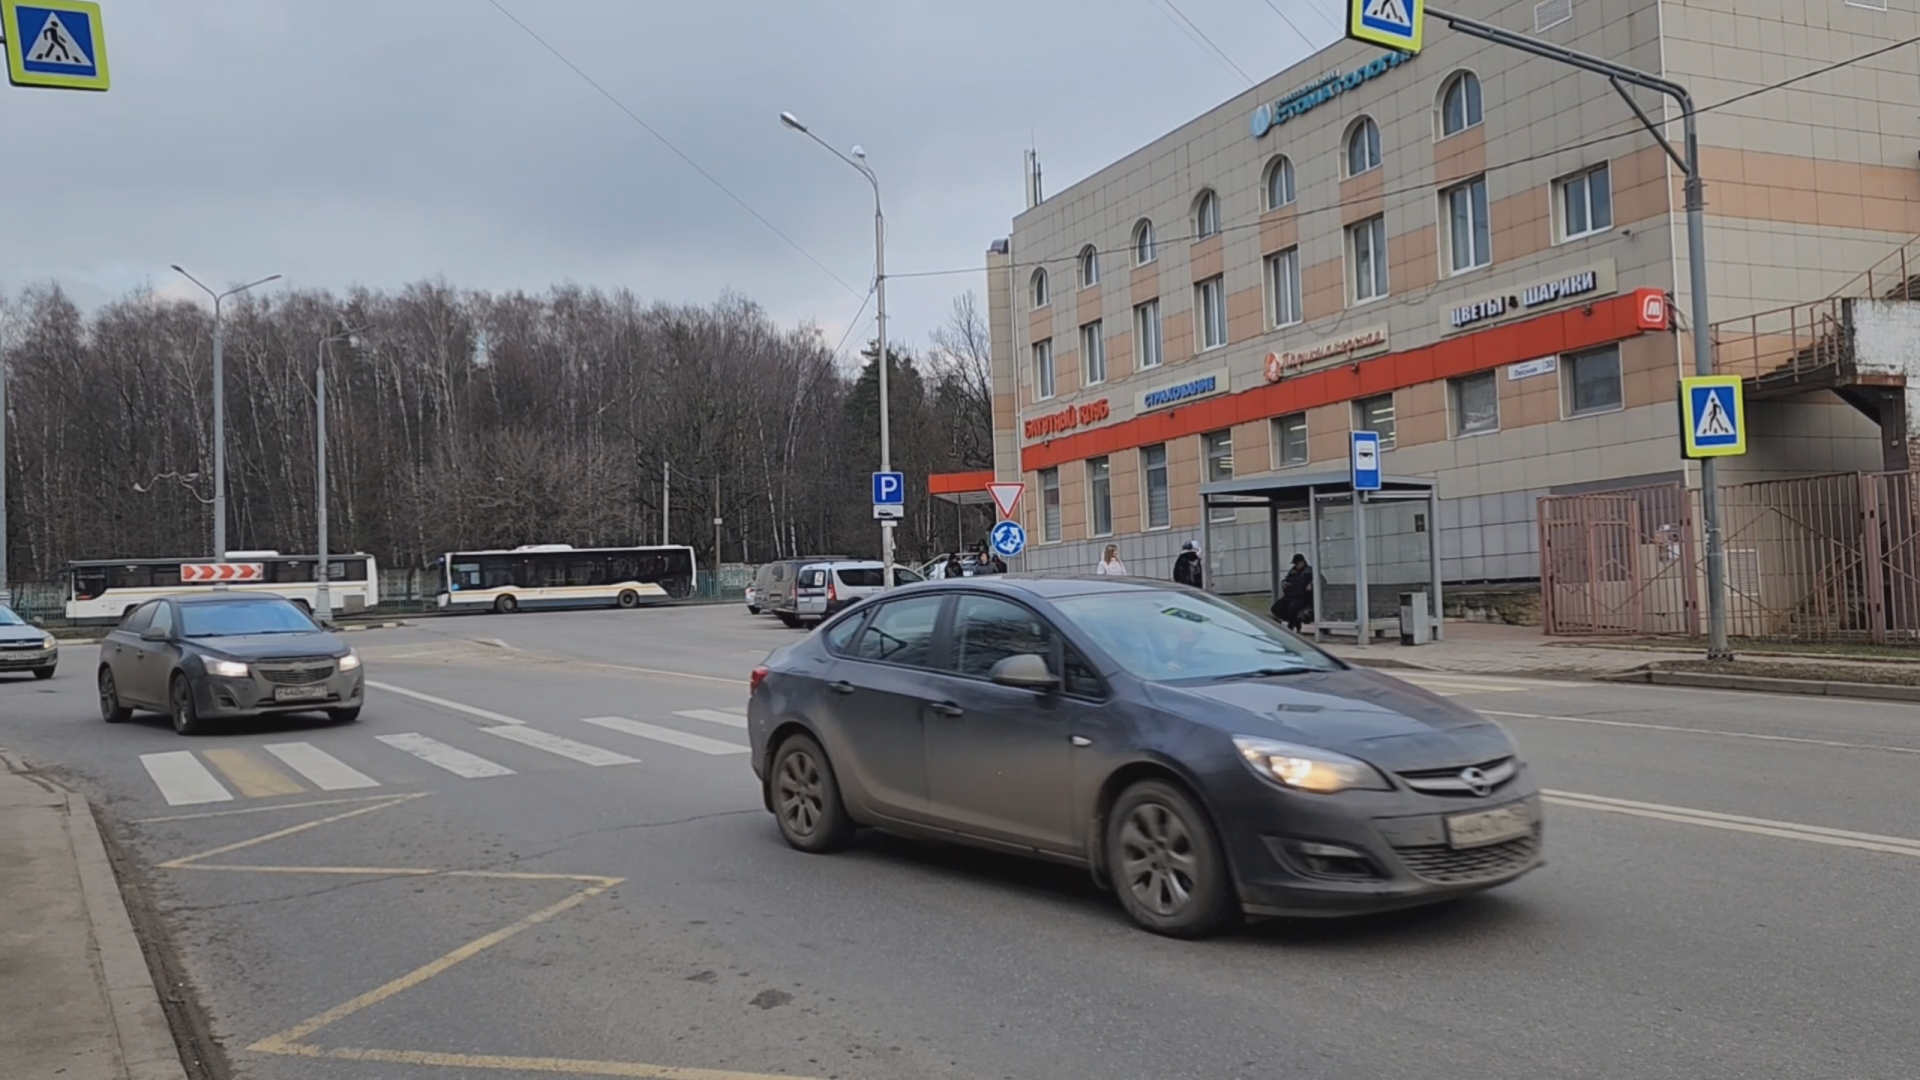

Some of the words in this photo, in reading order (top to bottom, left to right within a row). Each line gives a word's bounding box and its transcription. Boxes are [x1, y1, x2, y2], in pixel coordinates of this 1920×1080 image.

[1275, 51, 1410, 124] СТОМАТОЛОГИ
[1451, 297, 1505, 327] ЦВЕТЫ
[1522, 271, 1596, 307] ШАРИКИ
[1145, 376, 1215, 408] СТРАХОВАНИЕ
[1024, 405, 1077, 438] БАТУТНЫЙ
